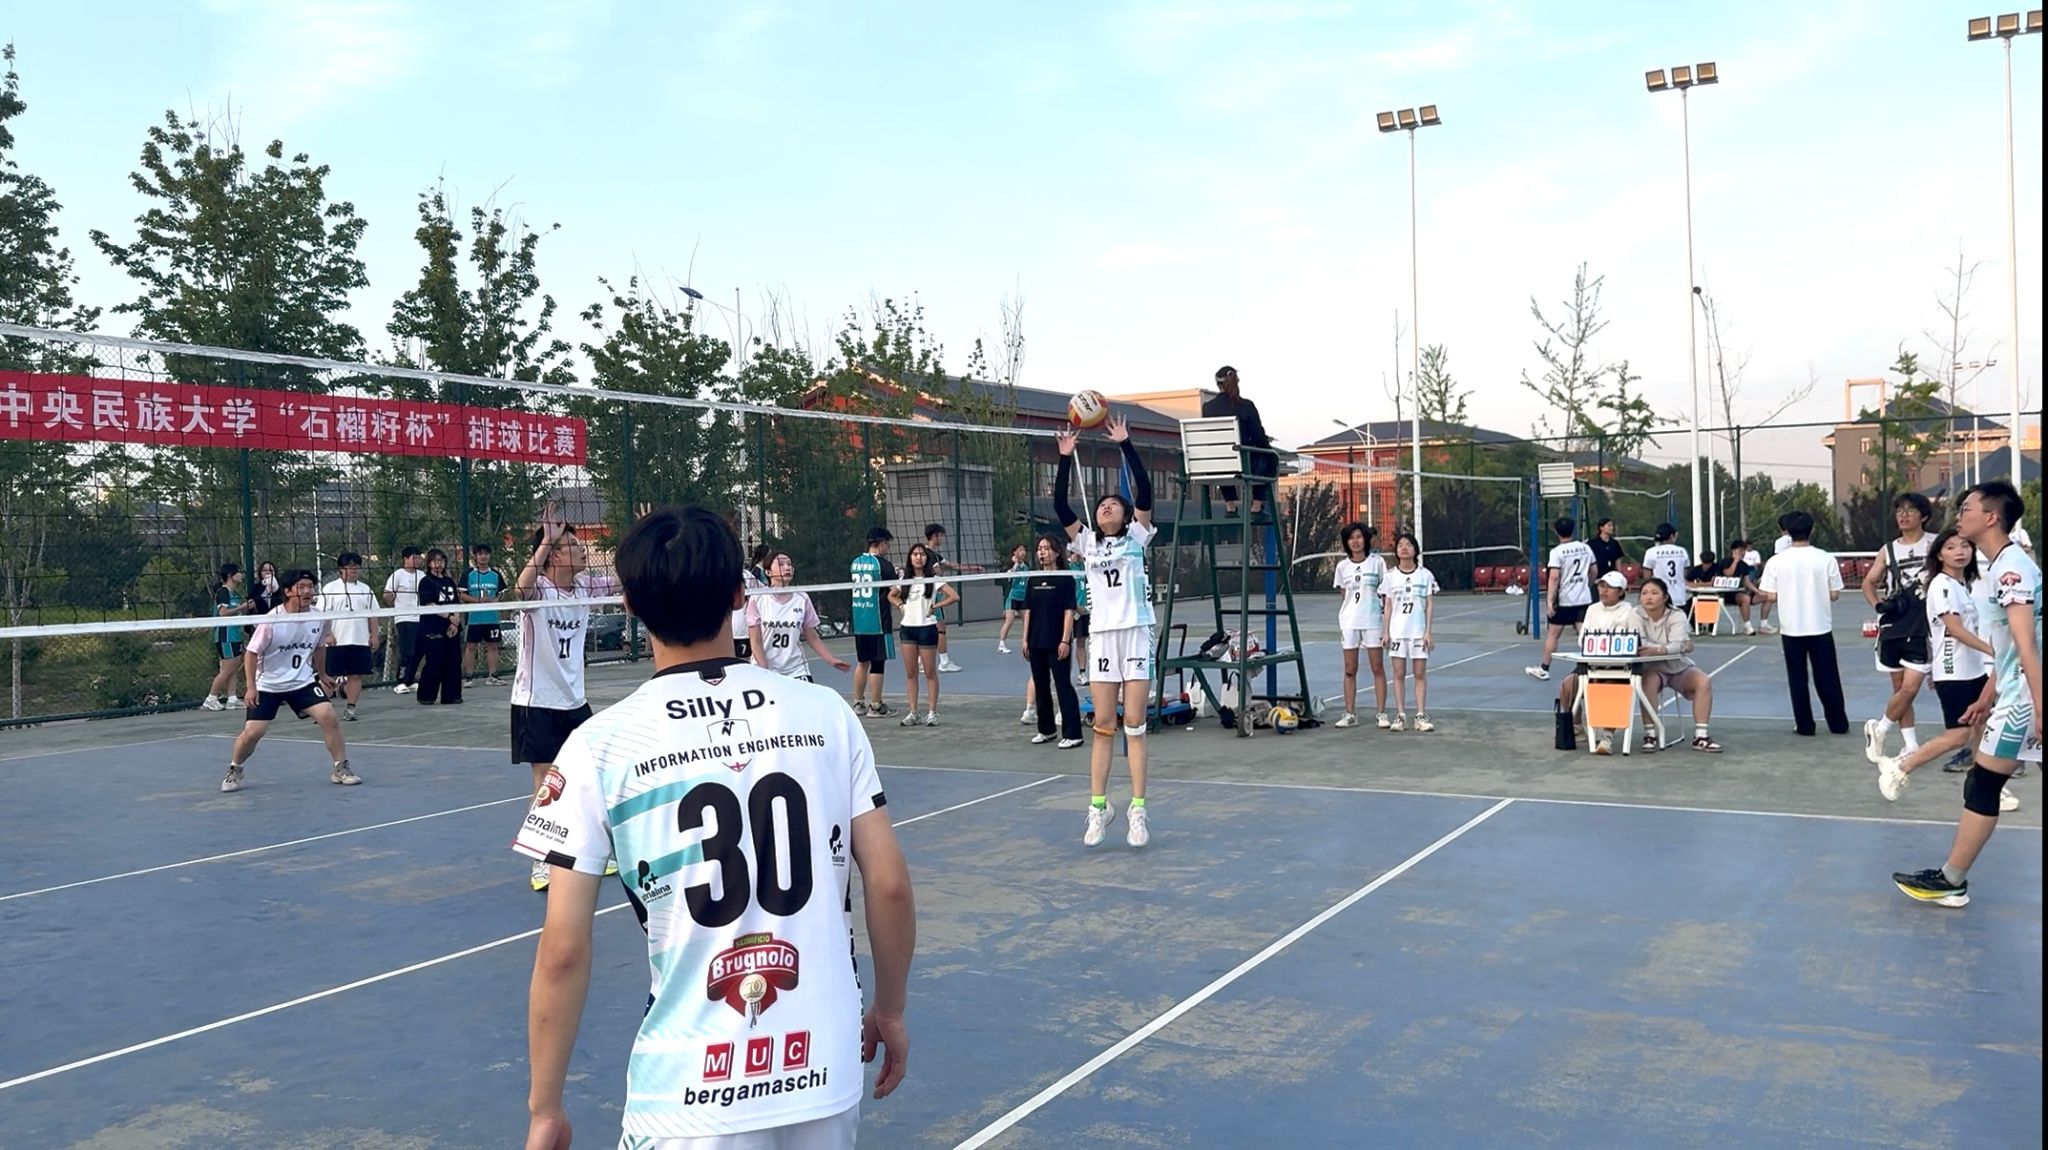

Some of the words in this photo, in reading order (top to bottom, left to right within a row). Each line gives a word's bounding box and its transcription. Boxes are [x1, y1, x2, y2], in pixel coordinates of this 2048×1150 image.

[1573, 558, 1581, 576] 2
[1667, 560, 1676, 578] 3
[1103, 568, 1122, 588] 12
[1355, 592, 1361, 604] 9
[1402, 602, 1414, 614] 27
[490, 629, 500, 638] 17
[772, 633, 789, 648] 20
[741, 644, 747, 655] 7
[1391, 642, 1400, 651] 27
[292, 655, 302, 669] 0
[1098, 657, 1109, 672] 12
[313, 686, 324, 697] 0
[665, 696, 733, 719] Silly
[742, 689, 775, 710] D.
[634, 745, 732, 777] INFORMATION
[738, 734, 825, 754] ENGINEERING
[677, 771, 813, 928] 30
[712, 946, 795, 980] Brugnolo
[683, 1067, 828, 1107] bergamaschi
